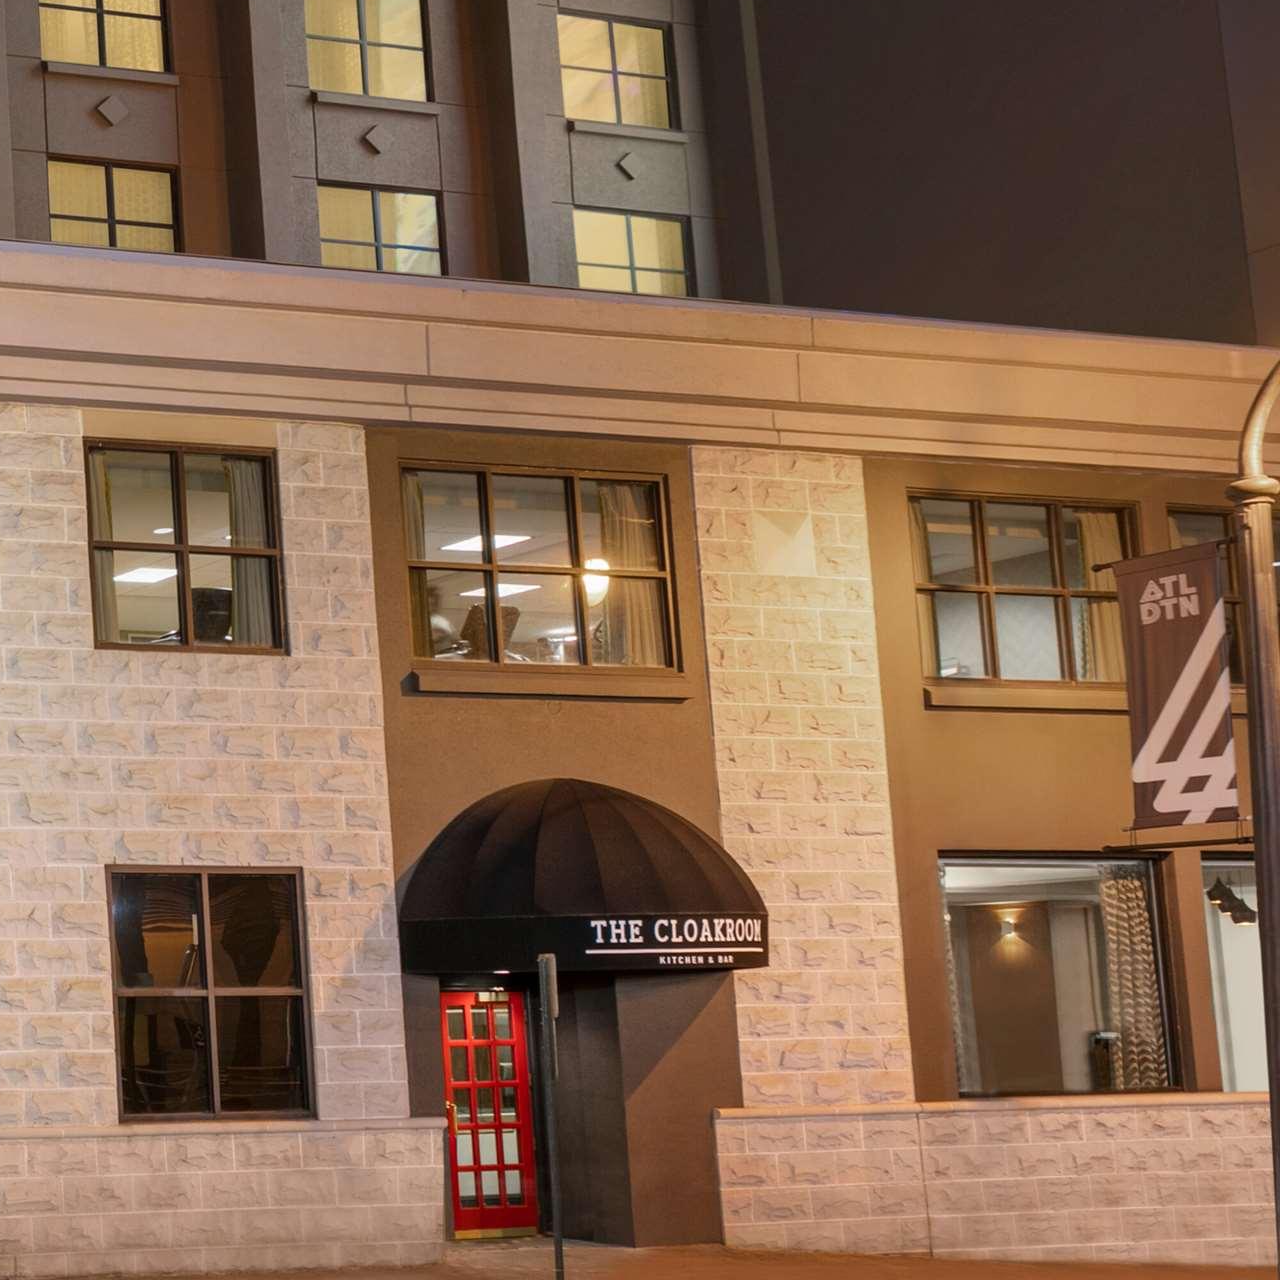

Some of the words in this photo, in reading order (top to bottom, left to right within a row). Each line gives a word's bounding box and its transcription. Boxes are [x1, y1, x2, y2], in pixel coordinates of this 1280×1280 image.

[1139, 573, 1197, 603] ATL
[1139, 594, 1200, 624] DTN
[591, 919, 644, 944] THE
[654, 918, 762, 943] CLOAKROOM
[659, 955, 704, 965] KITCHEN
[708, 955, 715, 964] &
[718, 955, 735, 964] BAR
